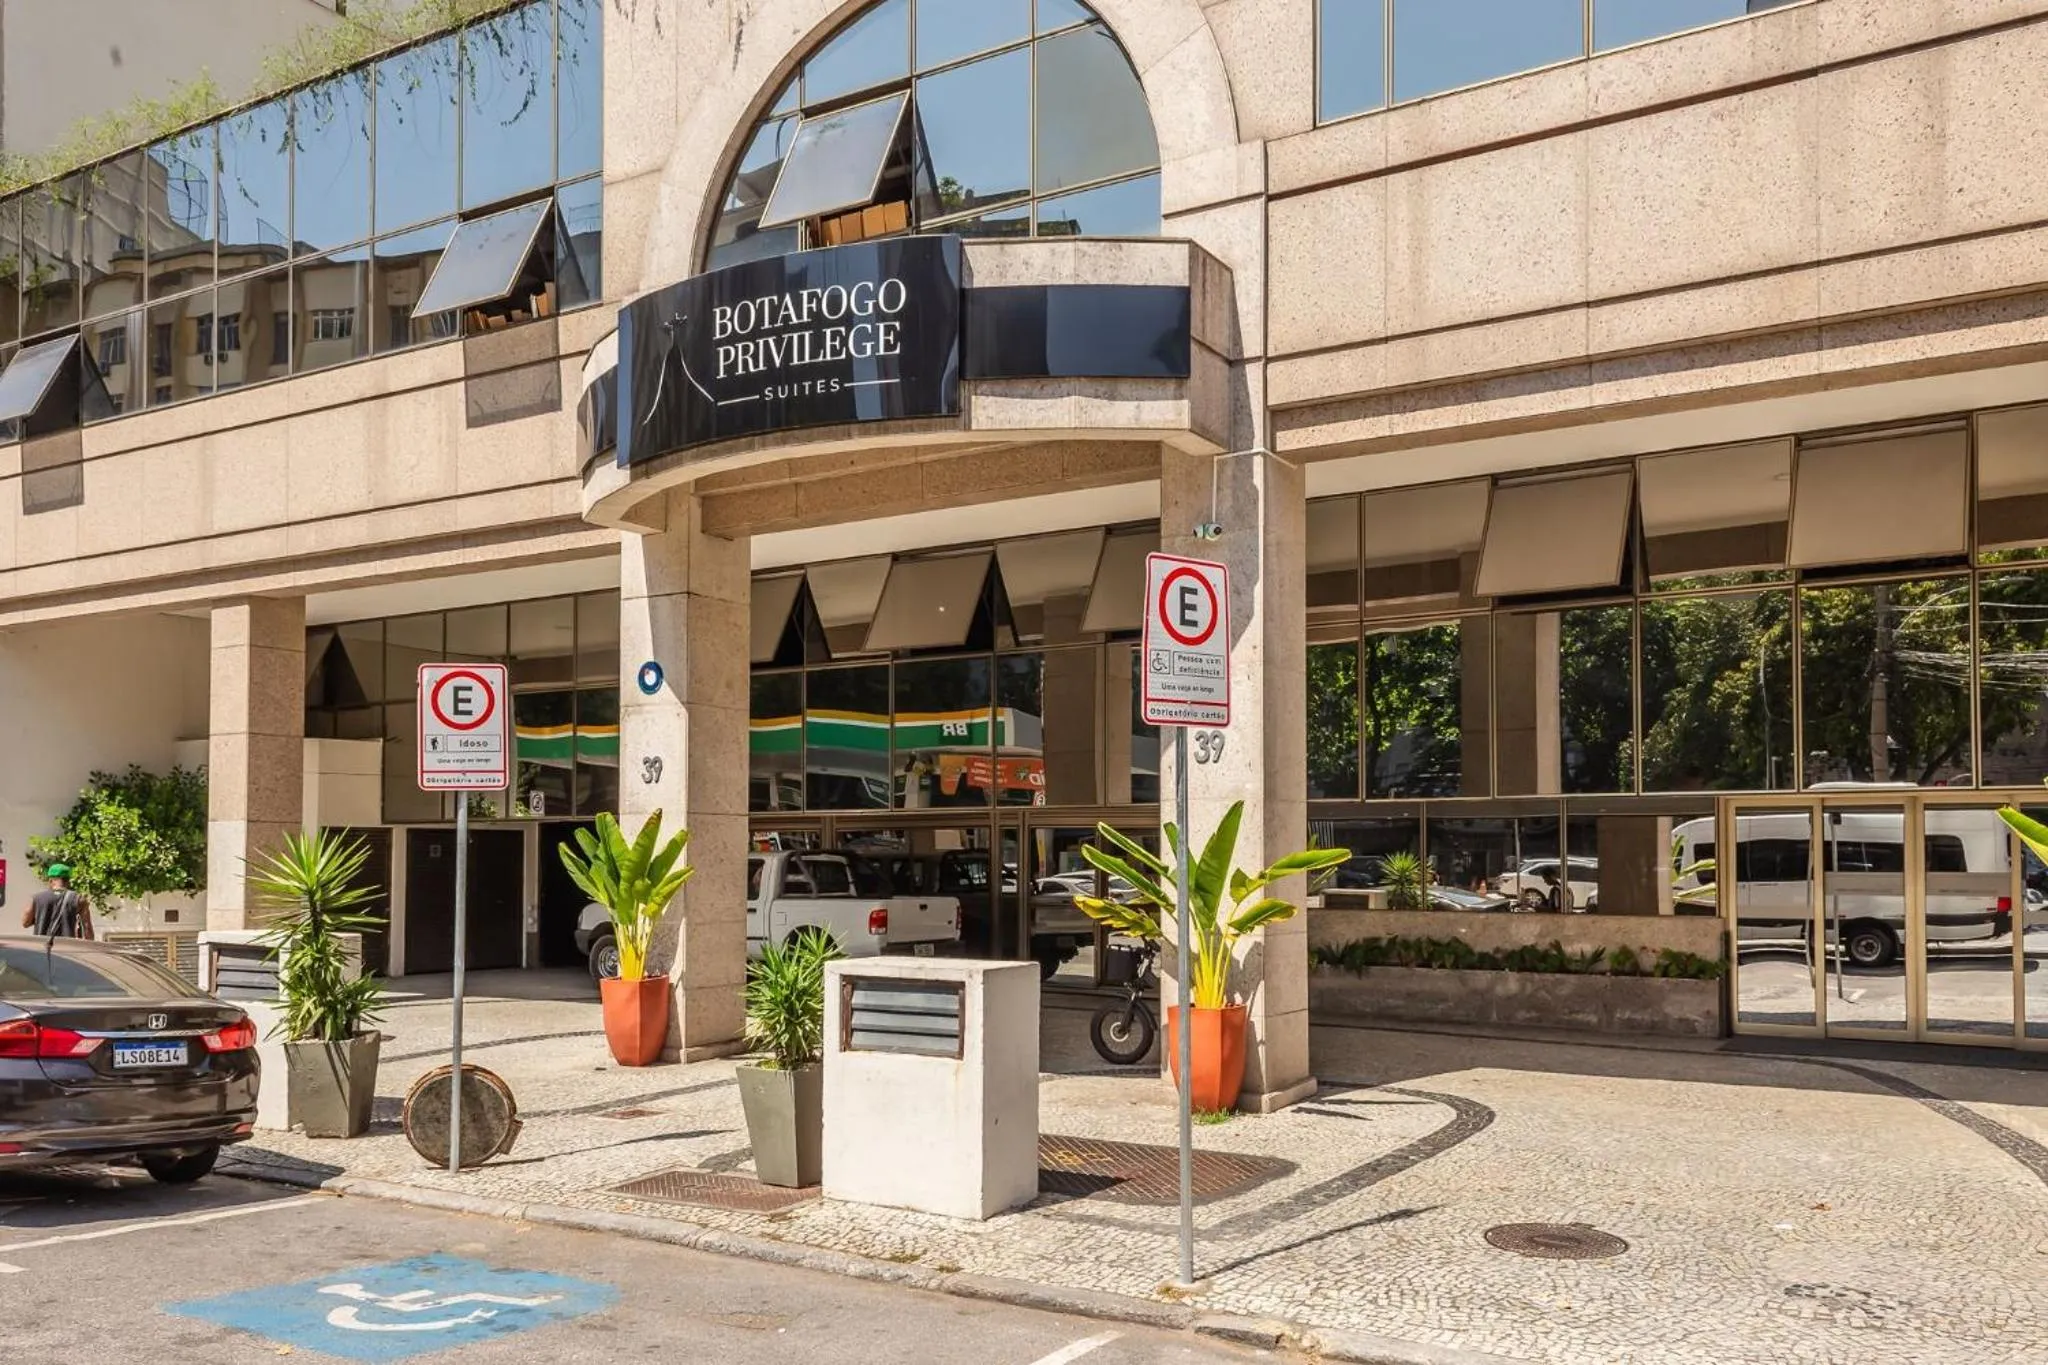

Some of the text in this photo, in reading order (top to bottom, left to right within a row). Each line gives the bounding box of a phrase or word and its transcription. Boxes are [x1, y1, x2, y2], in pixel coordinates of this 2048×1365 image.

[712, 278, 907, 341] BOTAFOGO
[716, 321, 901, 379] PRIVILEGE
[764, 378, 841, 401] SUITES
[1179, 585, 1199, 628] E
[1178, 655, 1203, 664] Pessoa
[452, 685, 473, 716] E
[1150, 707, 1198, 718] Obrigatório
[459, 739, 489, 747] Idoso
[1193, 729, 1226, 764] 39
[641, 755, 663, 784] 39
